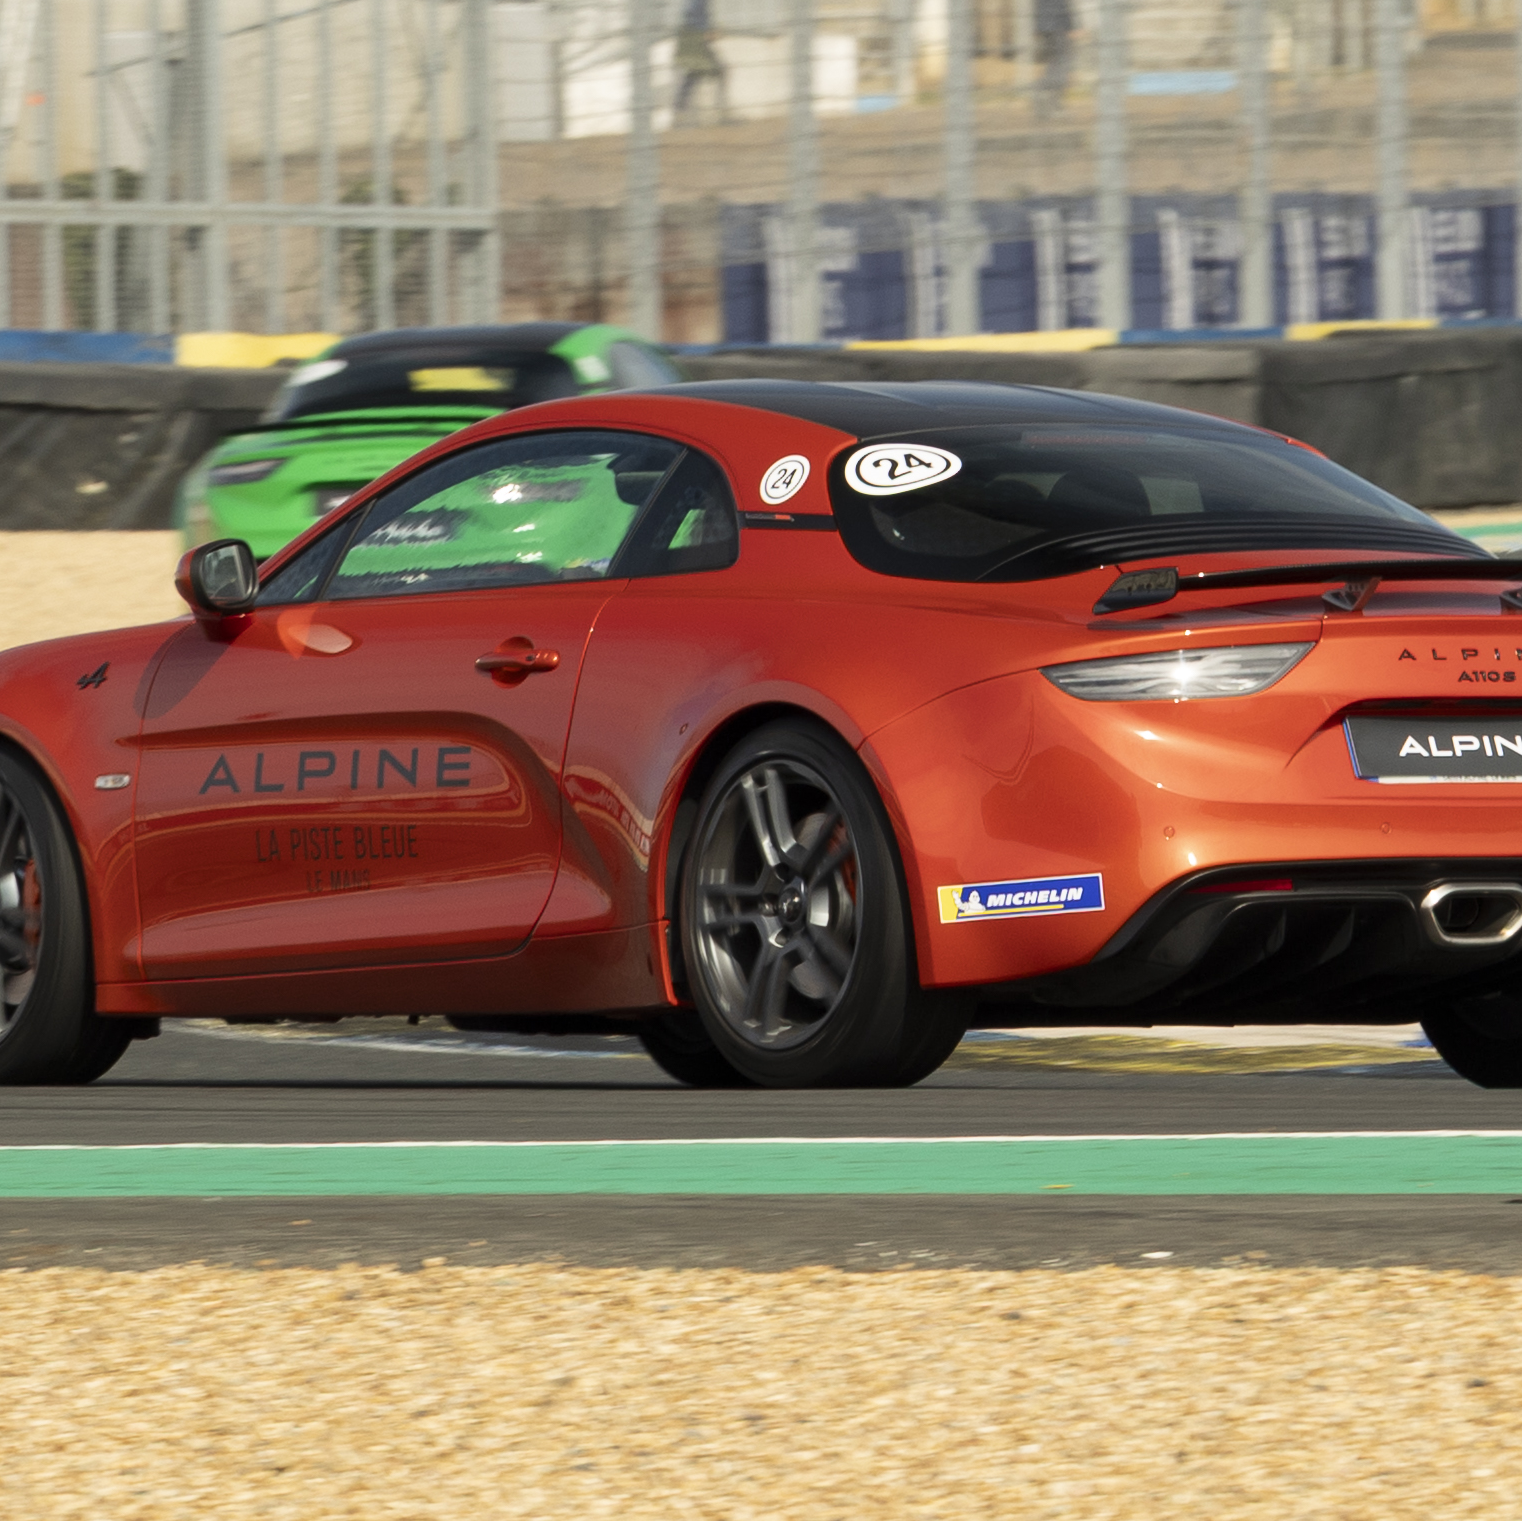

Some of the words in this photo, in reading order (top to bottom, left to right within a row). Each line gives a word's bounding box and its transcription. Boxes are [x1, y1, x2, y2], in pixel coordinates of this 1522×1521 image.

[770, 468, 798, 491] 24
[872, 453, 933, 481] 24
[198, 746, 472, 795] ALPINE
[255, 829, 282, 862] LA
[289, 826, 345, 861] PISTE
[352, 824, 419, 859] BLEUE
[306, 870, 323, 893] LE
[986, 886, 1084, 908] MICHELIN
